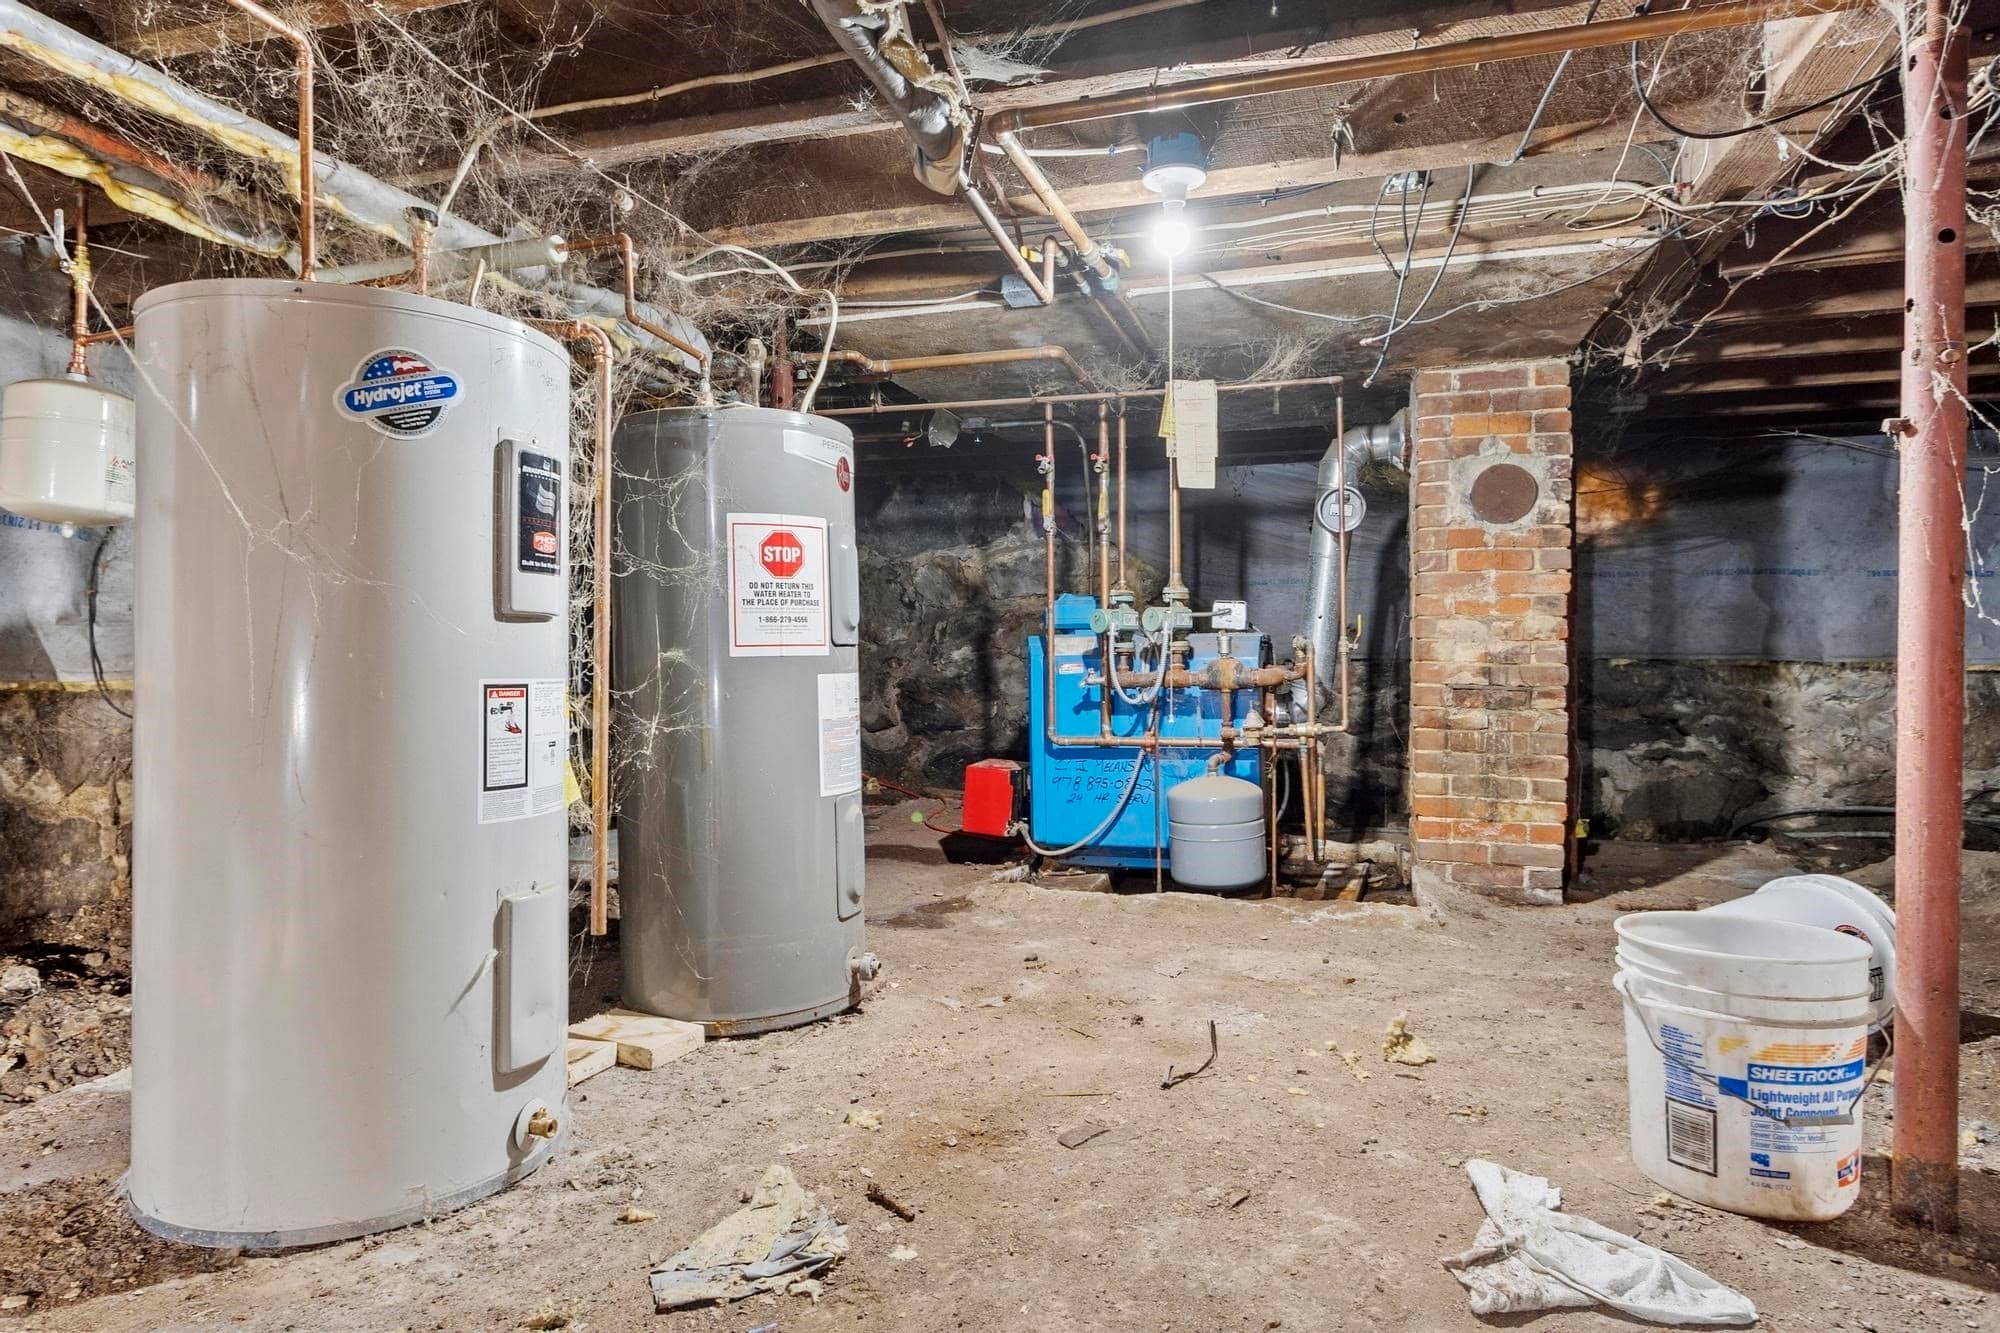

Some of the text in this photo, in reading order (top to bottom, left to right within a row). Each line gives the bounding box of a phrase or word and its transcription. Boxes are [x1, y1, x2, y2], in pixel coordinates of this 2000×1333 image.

[353, 382, 422, 408] Hydrojet
[763, 545, 801, 563] STOP
[775, 582, 800, 590] RETURN
[778, 590, 801, 598] HEATER
[790, 599, 820, 607] PURCHASE
[1750, 1066, 1846, 1082] SHEETROCK
[1751, 1088, 1820, 1106] Lightweight
[1823, 1090, 1835, 1103] All
